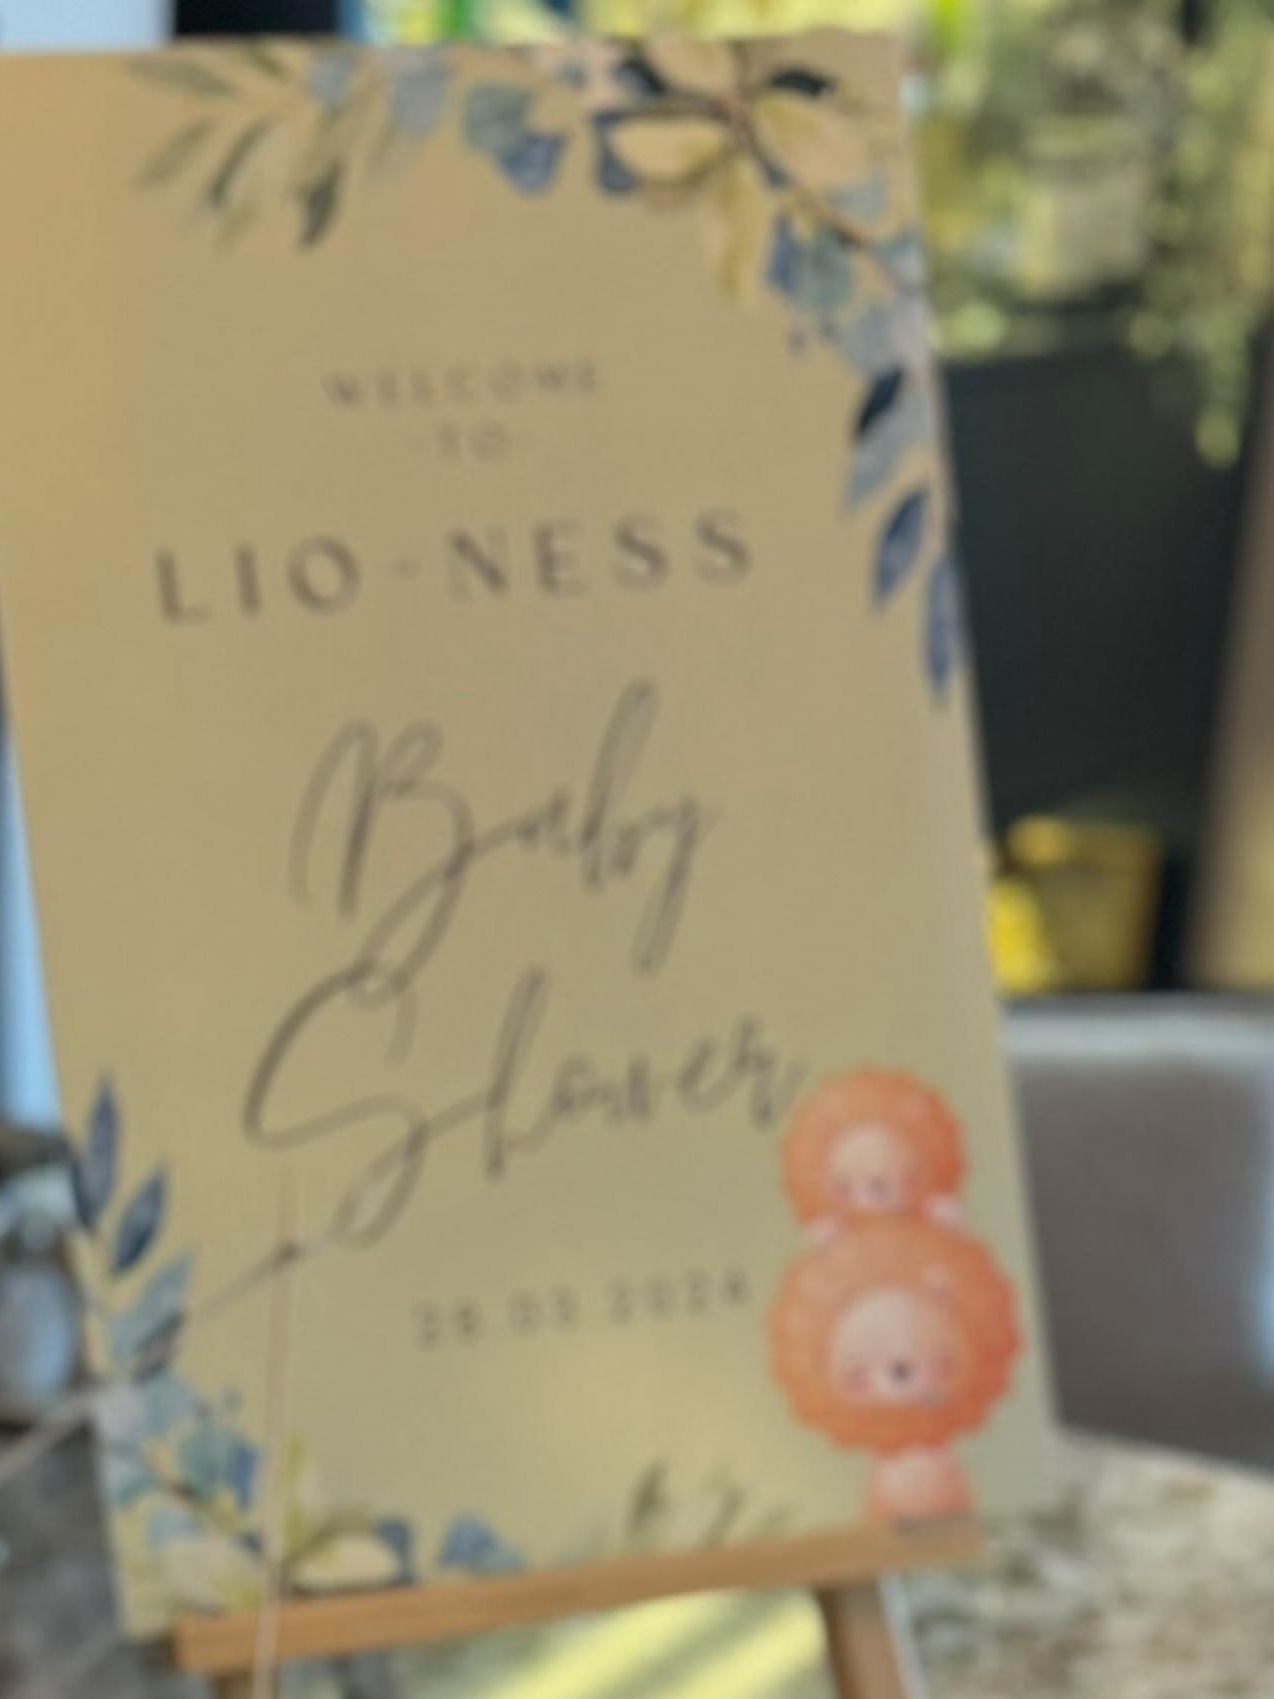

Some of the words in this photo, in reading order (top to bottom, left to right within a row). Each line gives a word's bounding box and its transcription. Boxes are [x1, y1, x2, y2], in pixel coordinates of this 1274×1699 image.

[324, 357, 603, 410] WELCOME
[289, 679, 711, 985] Baby
[241, 959, 807, 1248] Shower
